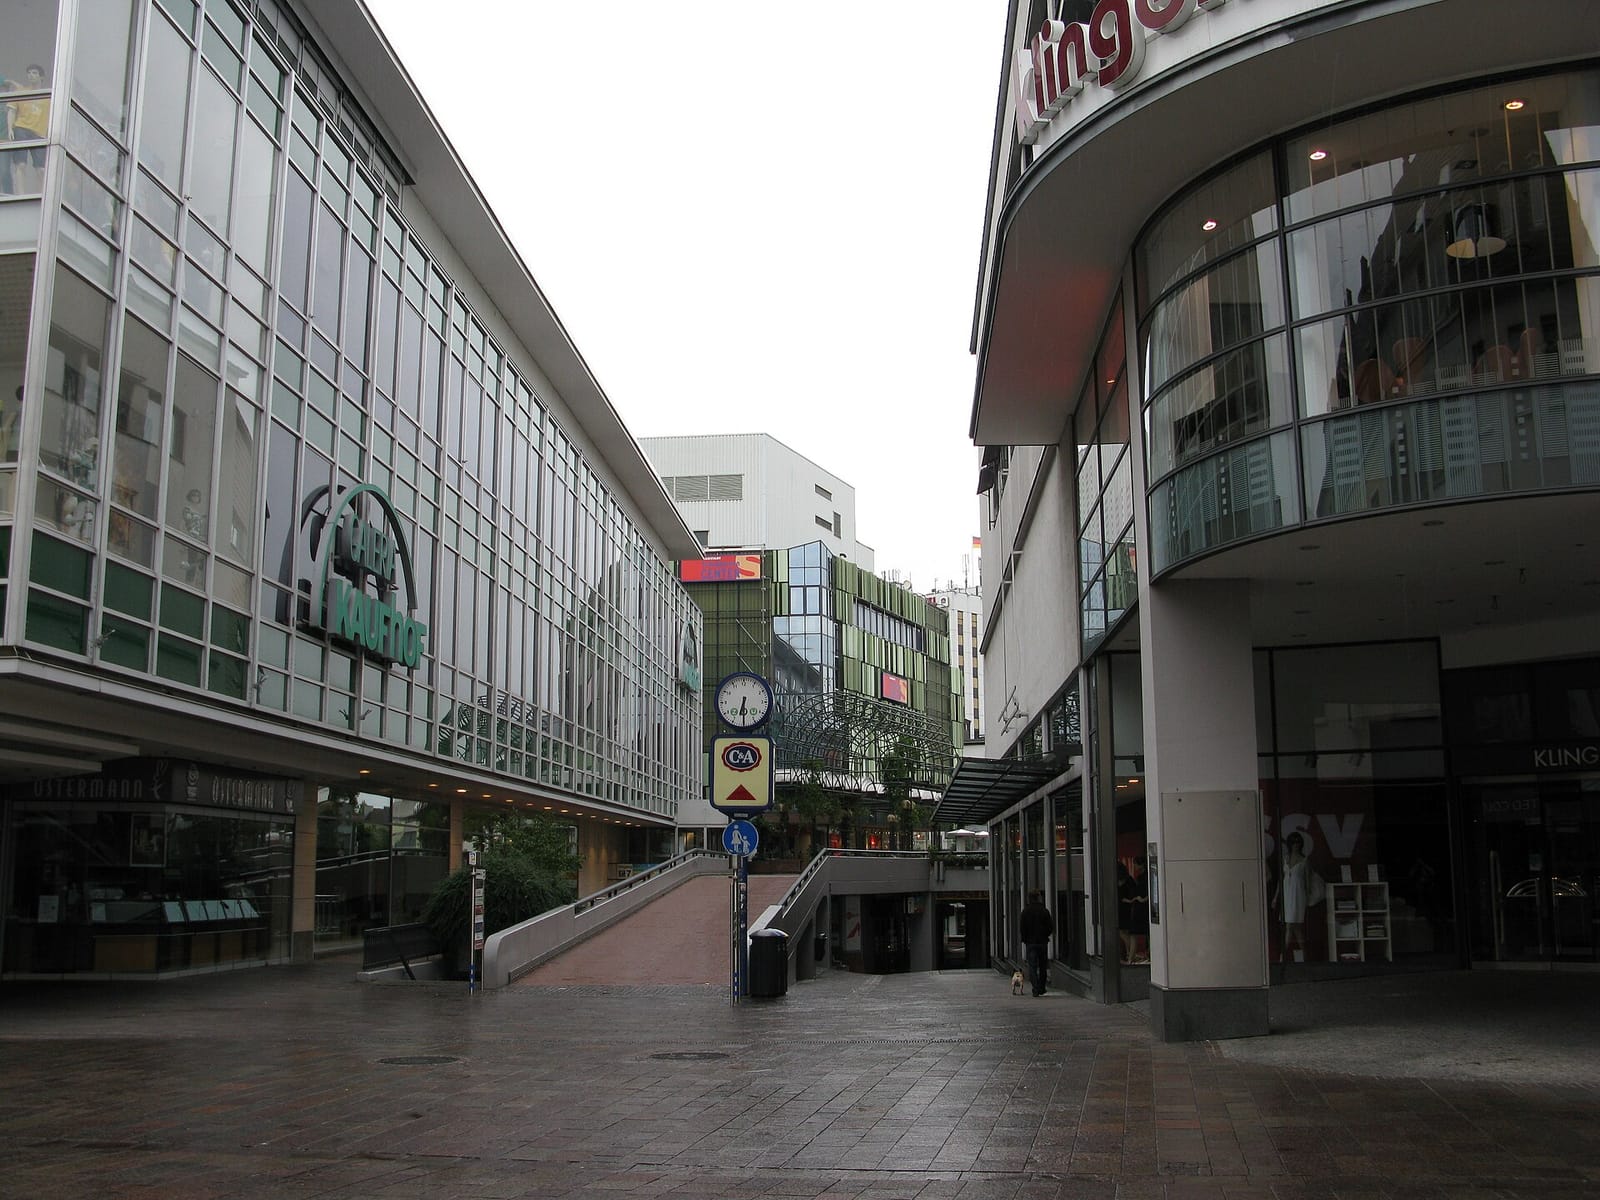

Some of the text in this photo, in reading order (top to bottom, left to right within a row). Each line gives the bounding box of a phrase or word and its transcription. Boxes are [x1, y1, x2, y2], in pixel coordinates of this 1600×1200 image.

[1011, 0, 1232, 145] kling
[729, 750, 755, 764] C&A
[1533, 746, 1600, 767] KLING
